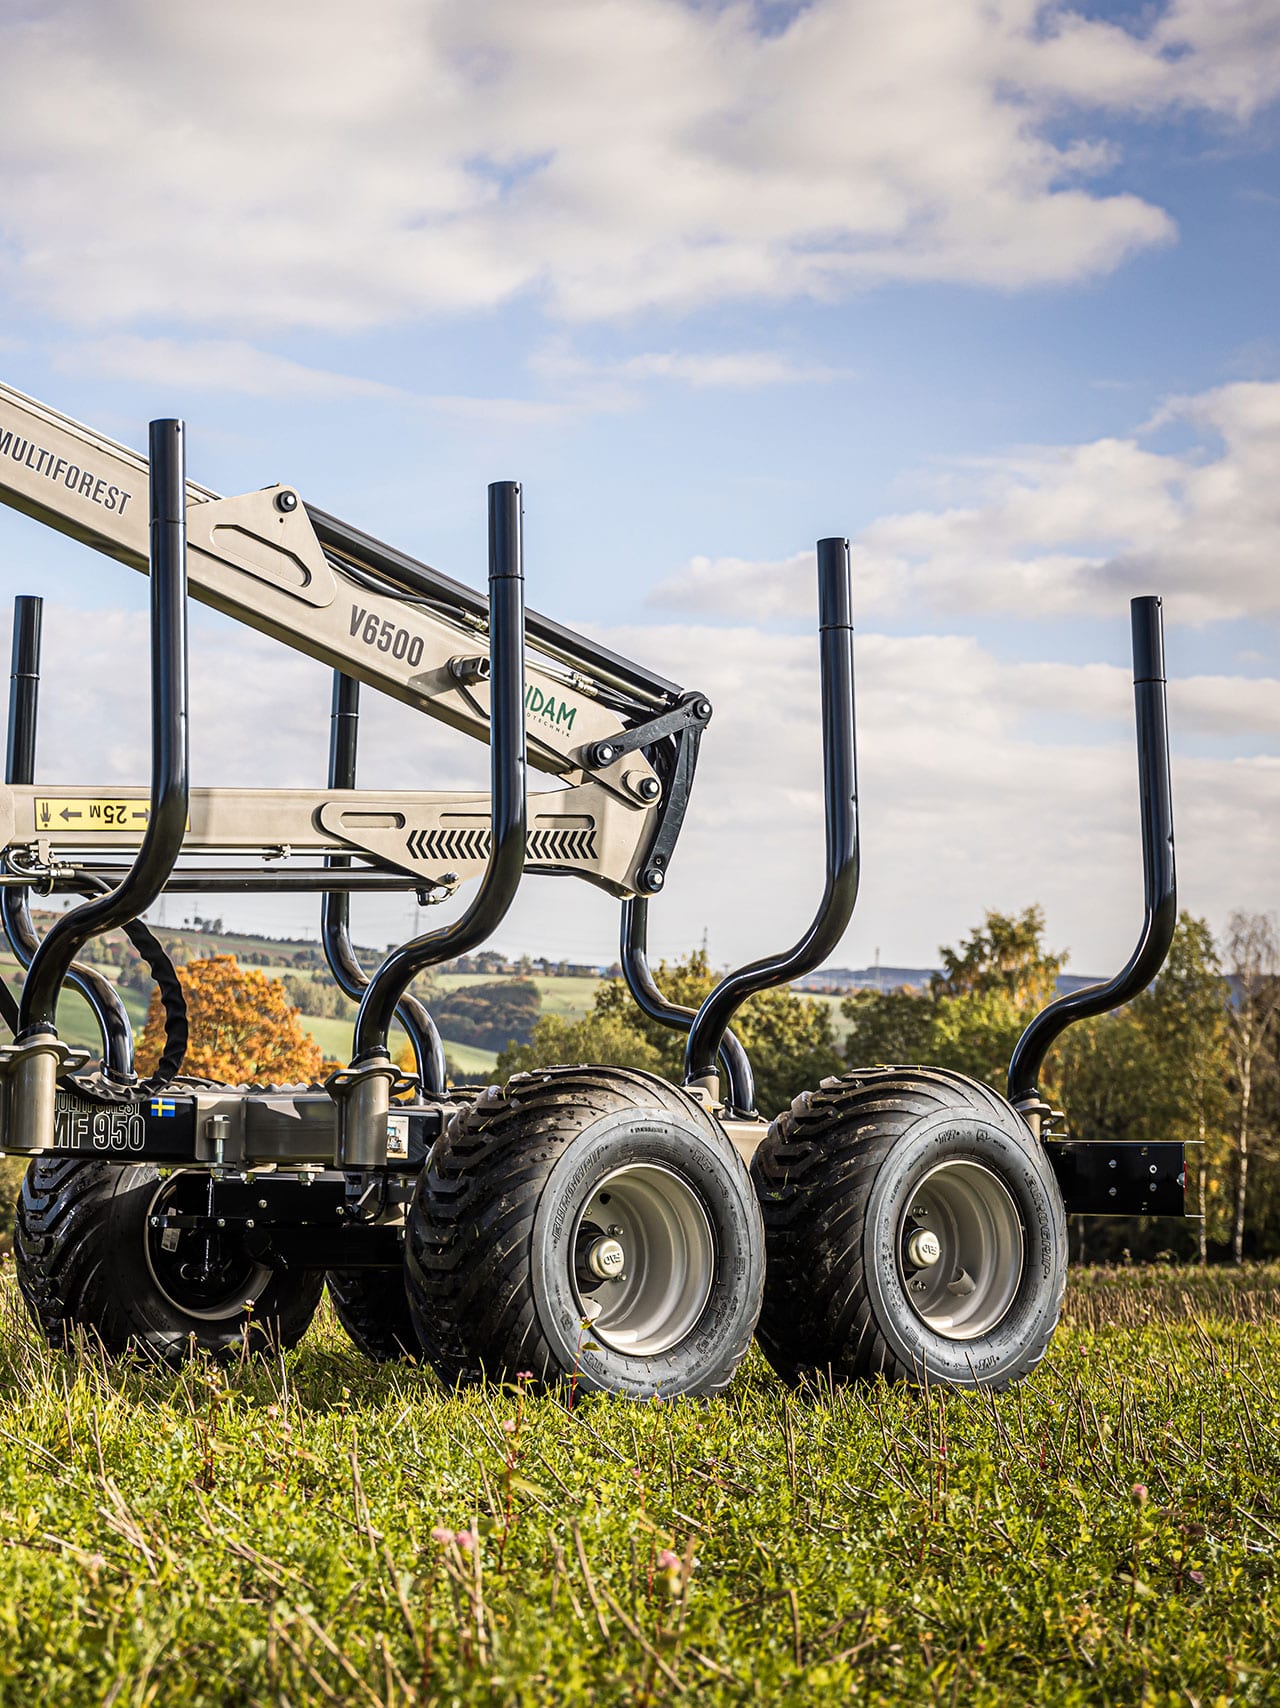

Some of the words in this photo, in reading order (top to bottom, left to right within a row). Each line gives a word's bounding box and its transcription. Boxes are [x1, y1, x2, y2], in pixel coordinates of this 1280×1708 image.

[349, 604, 425, 667] V6500
[524, 683, 577, 731] IDAM
[53, 1111, 89, 1149] MF
[93, 1113, 145, 1151] 950
